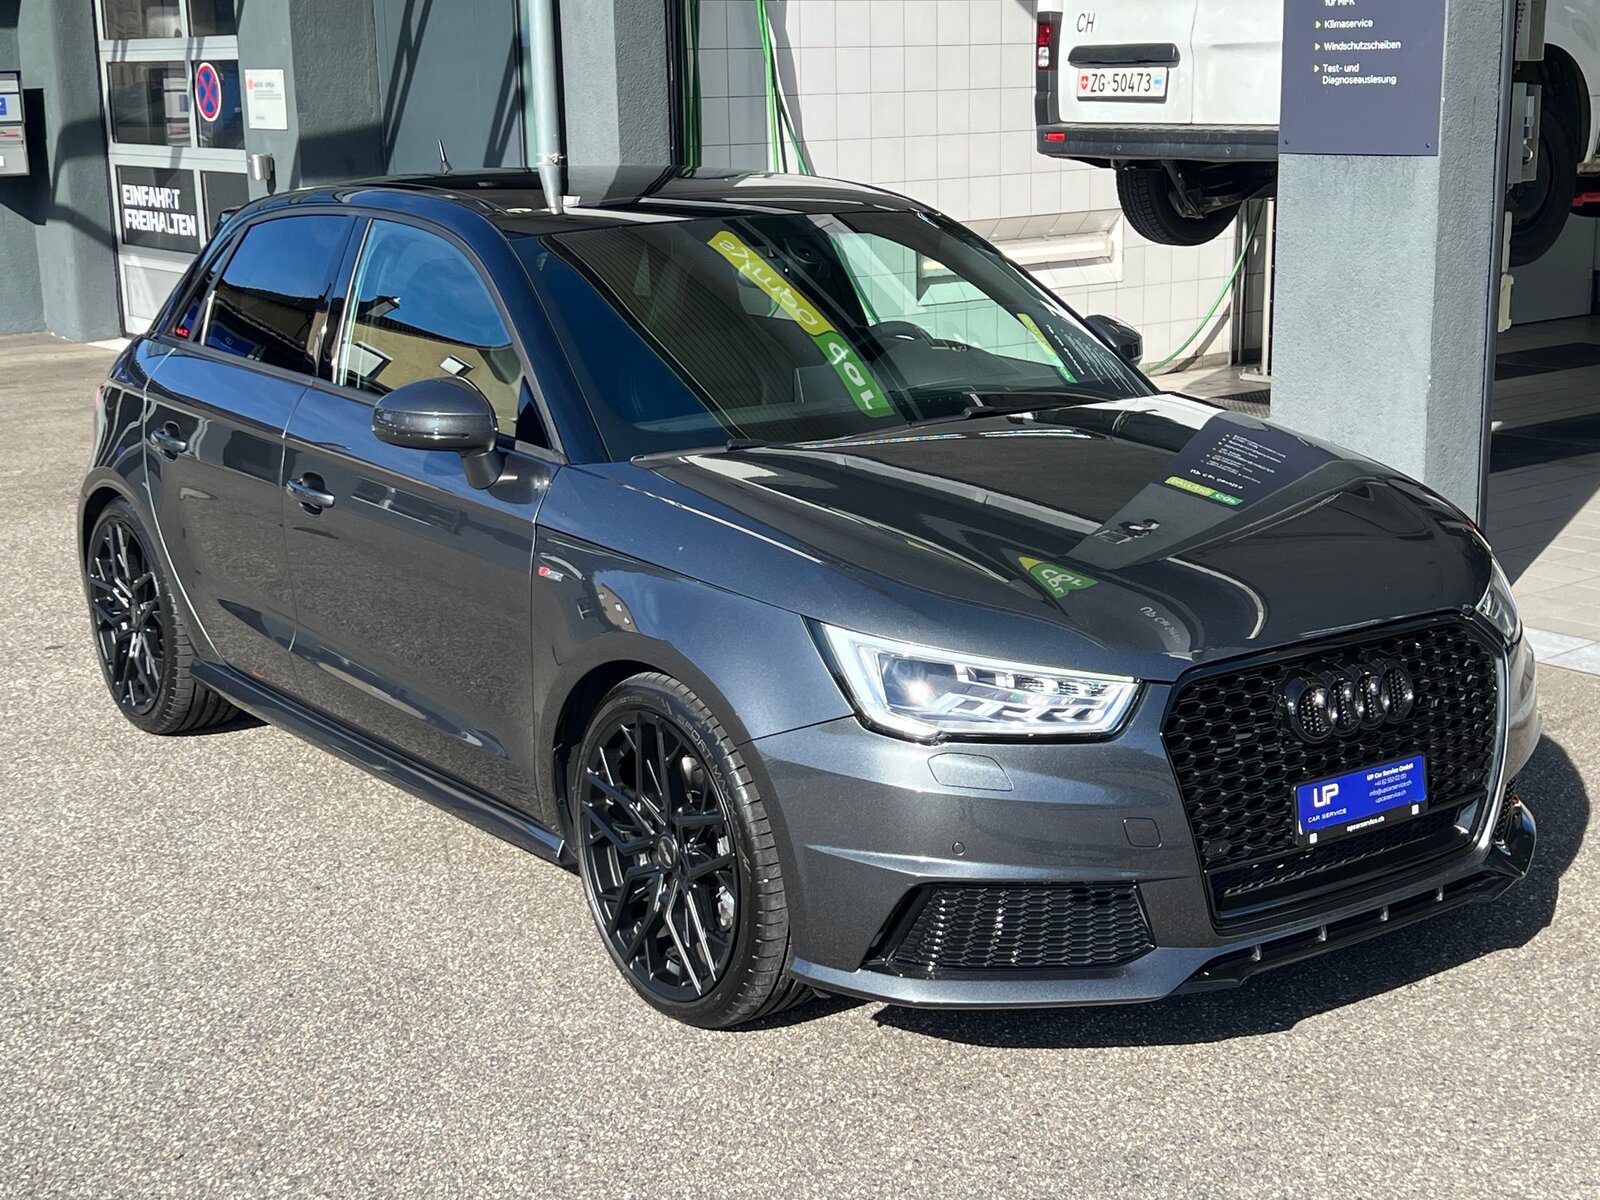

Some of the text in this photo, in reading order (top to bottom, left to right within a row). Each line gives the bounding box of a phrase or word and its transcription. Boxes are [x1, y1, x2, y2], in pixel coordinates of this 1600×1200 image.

[1076, 12, 1096, 33] CH
[1324, 19, 1374, 29] Klimaservice
[1323, 40, 1402, 51] Windschutzscheiben
[1322, 63, 1360, 73] Test- und
[1322, 74, 1397, 86] Diagnoseauslesung
[121, 184, 181, 211] EINFAHRT
[124, 208, 197, 237] FREIHALTEN
[675, 713, 738, 816] SPORT MAXX
[1382, 767, 1399, 776] Service
[1313, 783, 1339, 808] UP
[1308, 808, 1348, 824] CAR SERVICE
